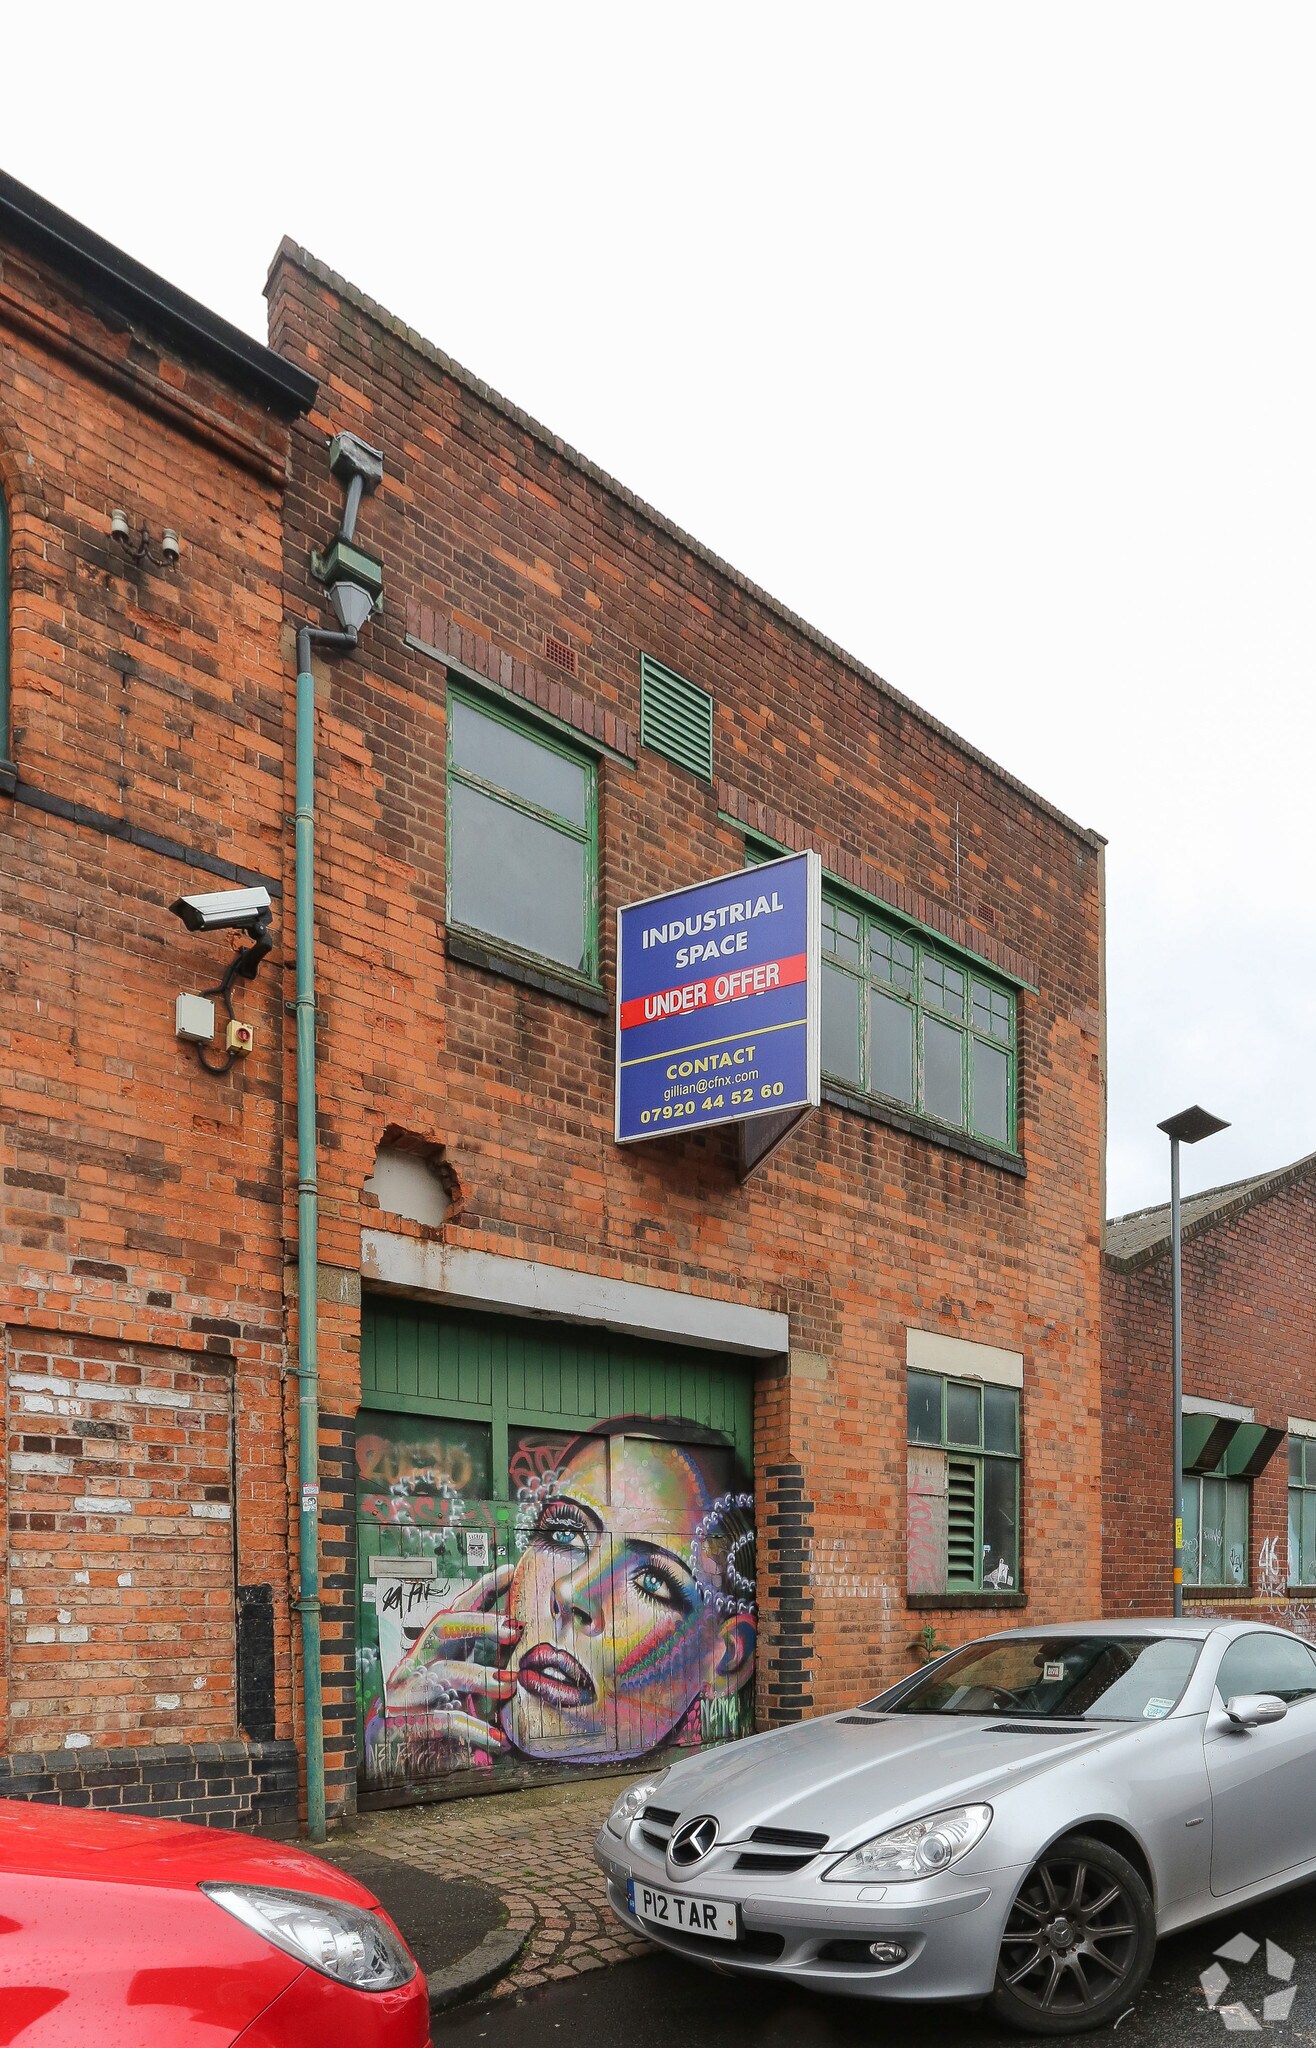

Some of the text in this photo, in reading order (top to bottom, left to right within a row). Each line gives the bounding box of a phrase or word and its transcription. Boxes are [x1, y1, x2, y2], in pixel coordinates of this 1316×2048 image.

[642, 892, 784, 949] INDUSTRIAL
[675, 931, 748, 969] SPACE
[644, 963, 780, 1019] UNDER OFFER
[666, 1046, 756, 1080] CONTACT
[640, 1081, 784, 1124] 07920 44 52 60
[663, 1069, 759, 1102] gillian@cfnx.com
[643, 1889, 717, 1931] P12 TAR
